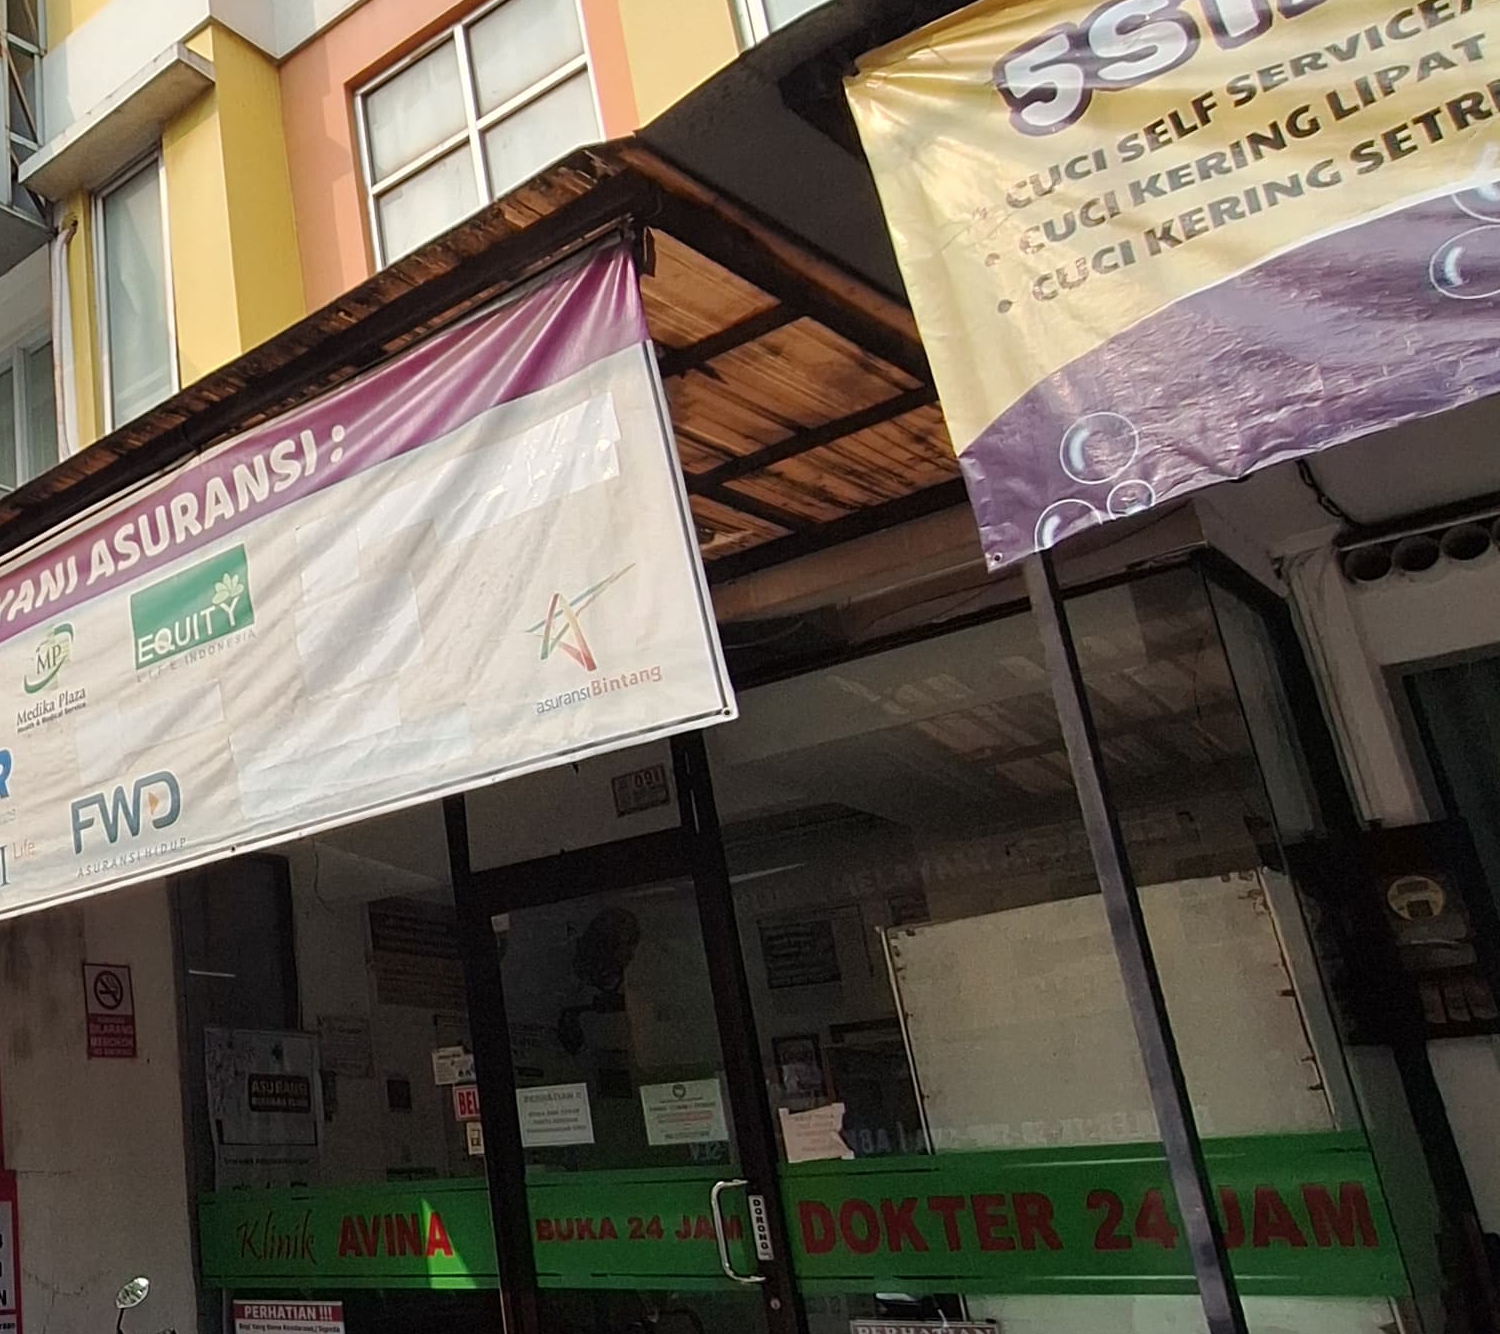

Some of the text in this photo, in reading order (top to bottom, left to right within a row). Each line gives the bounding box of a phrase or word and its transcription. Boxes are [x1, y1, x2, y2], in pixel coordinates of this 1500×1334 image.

[1006, 148, 1107, 210] CUCI
[1119, 90, 1218, 164] SELF
[1019, 32, 1487, 255] CUCI KERING LIPAT
[1032, 240, 1135, 302] CUCI
[1144, 159, 1342, 257] KERING
[87, 429, 318, 586] ASURANSI
[138, 596, 239, 664] EQUITY
[17, 688, 86, 726] Medika Plaza
[71, 771, 181, 855] FWD
[236, 1208, 454, 1266] Klinik AVINA
[536, 1215, 744, 1242] BUKA 24 JAM
[753, 1199, 769, 1249] DORONG
[798, 1182, 1379, 1256] DOKTER 24 JAM
[244, 1306, 316, 1319] PERHATIAN
